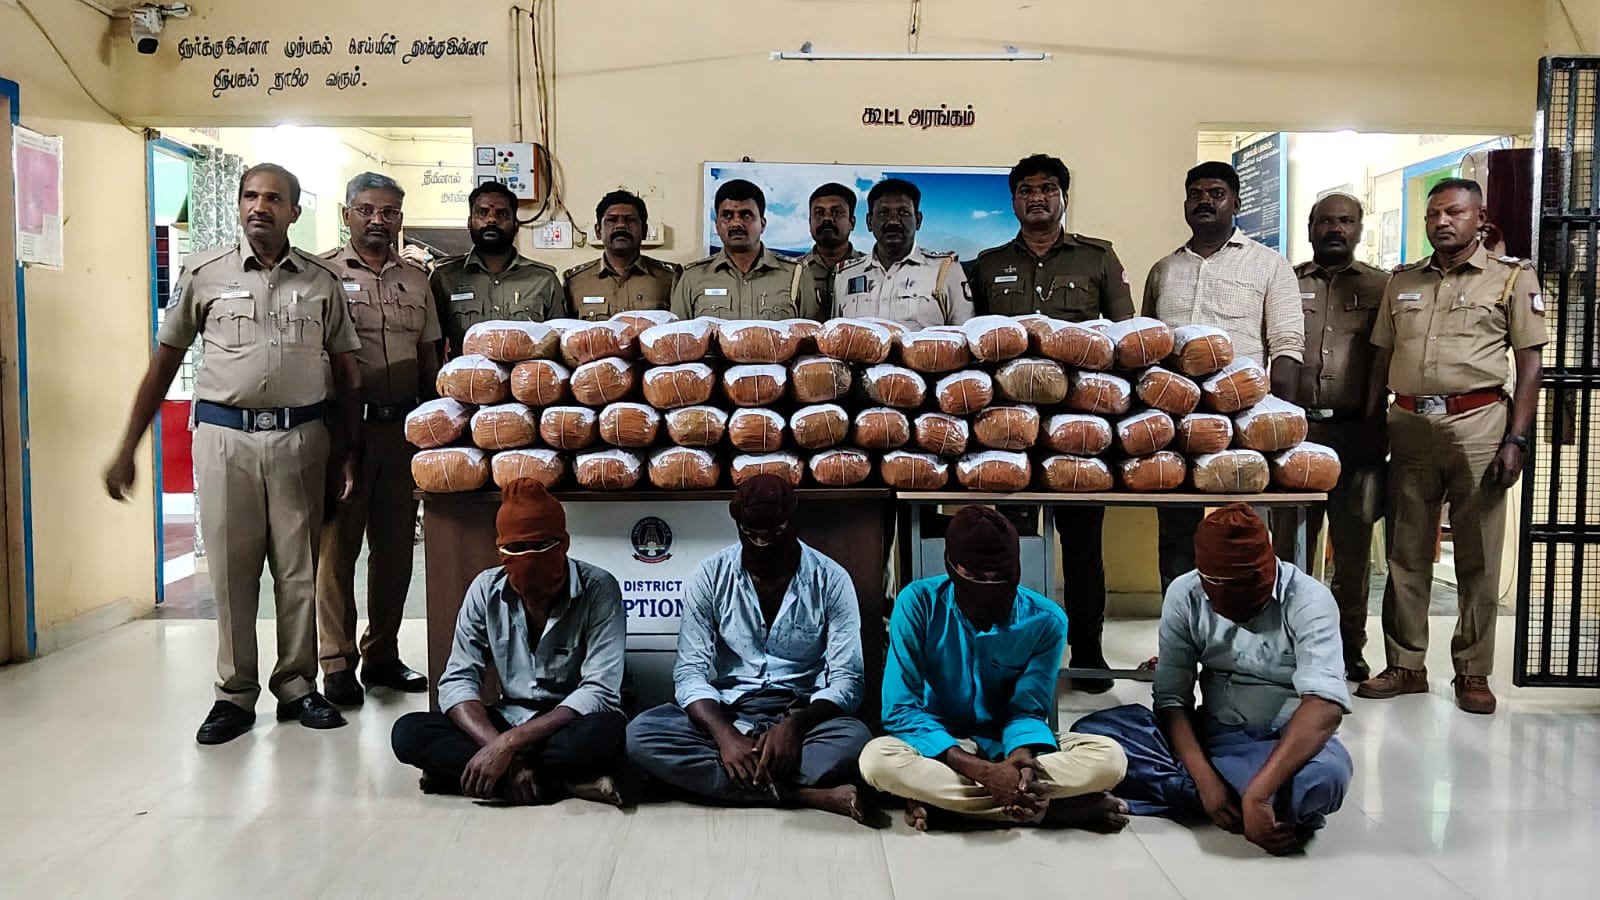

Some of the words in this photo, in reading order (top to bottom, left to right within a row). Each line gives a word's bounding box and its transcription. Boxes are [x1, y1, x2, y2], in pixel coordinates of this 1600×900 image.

[862, 107, 904, 125] கூட்ட
[908, 103, 975, 129] அரங்கம்
[624, 580, 682, 592] DISTRICT
